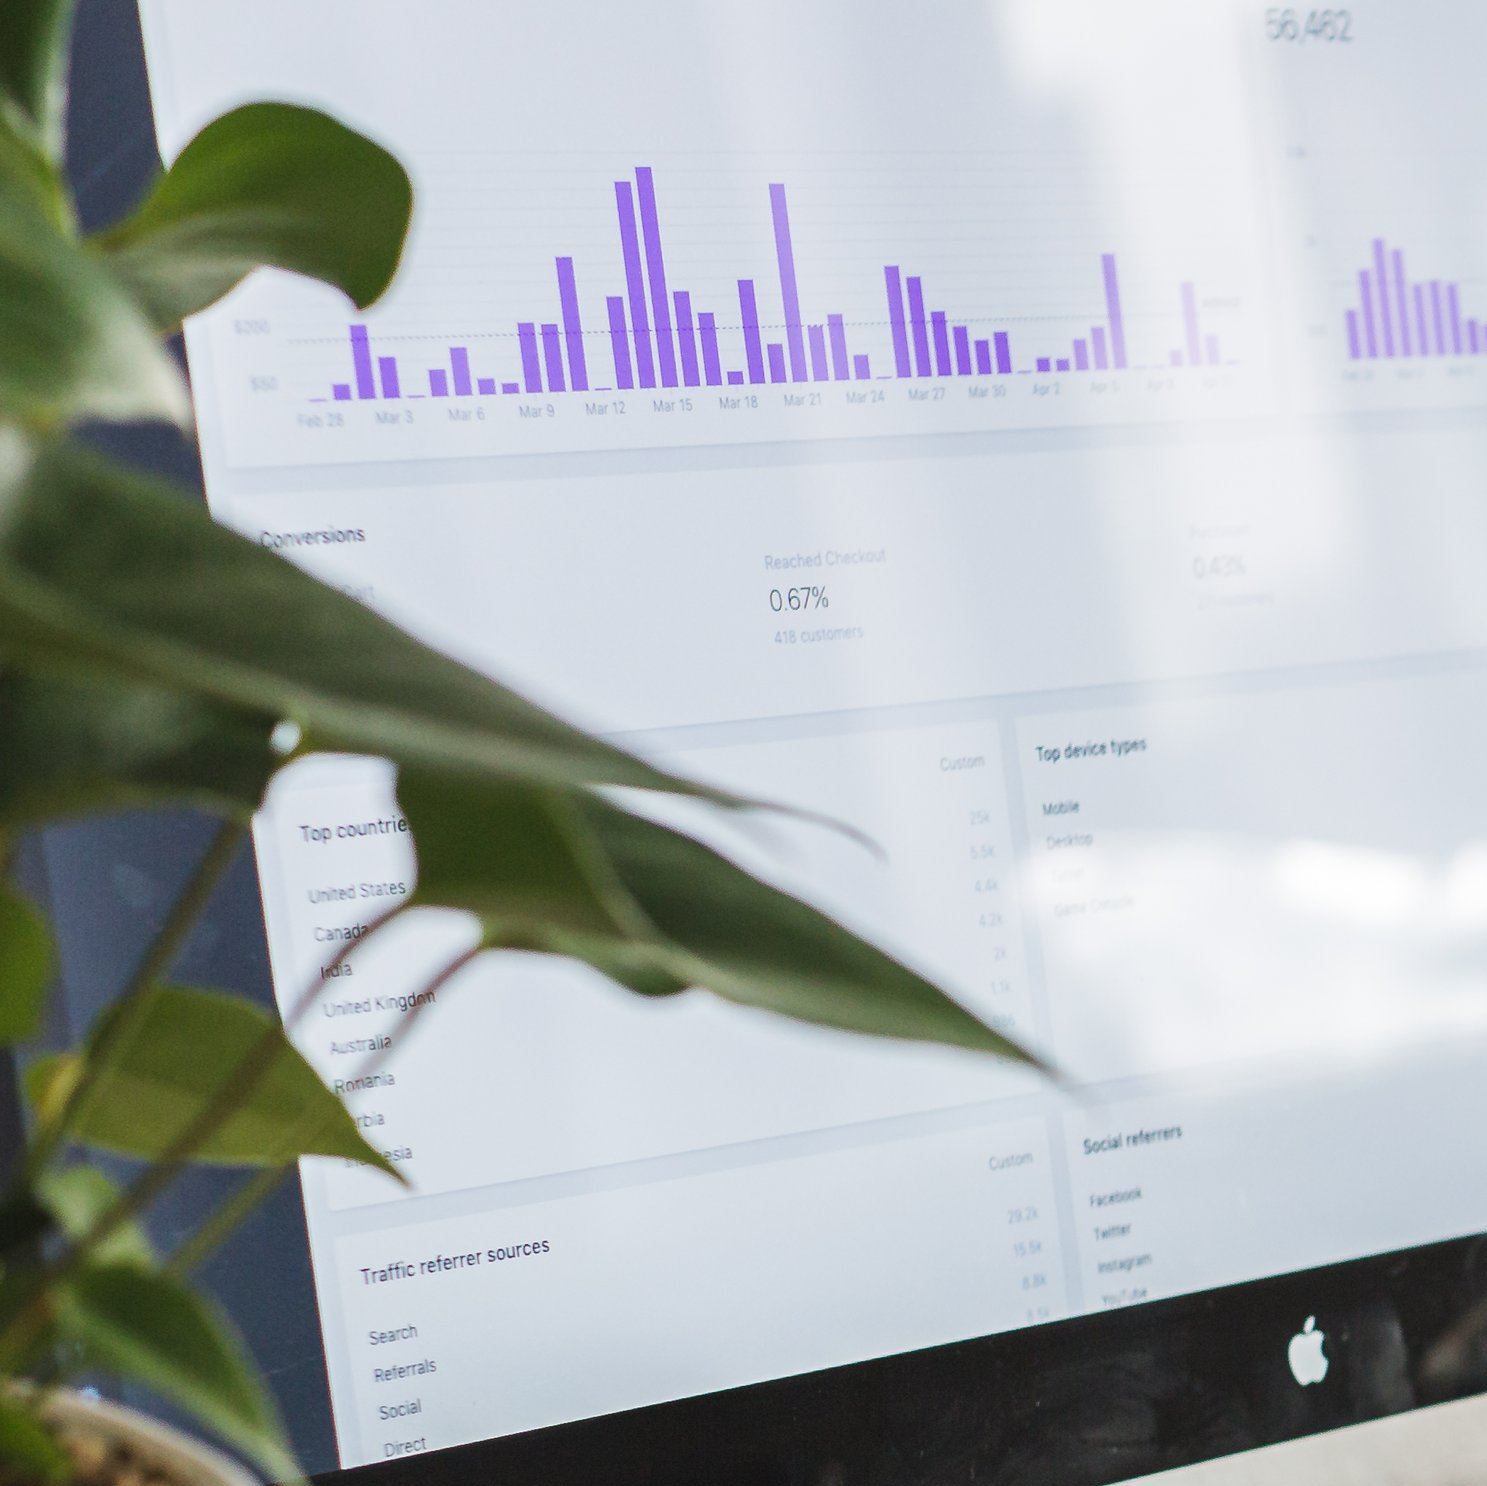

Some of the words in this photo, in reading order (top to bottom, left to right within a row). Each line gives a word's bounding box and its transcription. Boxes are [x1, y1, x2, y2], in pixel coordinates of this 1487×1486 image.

[719, 396, 741, 411] Mar
[742, 395, 759, 410] 18
[783, 393, 805, 408] Mar
[806, 392, 822, 407] 21
[846, 391, 868, 406] Mar
[908, 387, 930, 401] Mar
[449, 409, 475, 423] Mar
[476, 407, 486, 421] 6
[519, 405, 545, 420] Mar
[546, 404, 556, 418] 9
[585, 402, 607, 417] Mar
[608, 400, 627, 416] 12
[653, 400, 676, 414] Mar
[677, 398, 694, 413] 15
[375, 411, 400, 426] Mar
[260, 523, 367, 549] Conversions
[764, 553, 822, 570] Reached
[824, 548, 887, 566] Checkout
[768, 586, 829, 614] 0.67%
[774, 629, 797, 645] 418
[799, 624, 864, 642] customers
[939, 754, 986, 772] Custom
[1034, 744, 1060, 765] Top
[297, 825, 332, 846] Top
[336, 817, 408, 840] countrie
[307, 885, 357, 905] United
[359, 880, 406, 899] States
[313, 923, 369, 943] Canada
[324, 1001, 371, 1019] United
[329, 1033, 392, 1056] Australia
[1083, 1132, 1123, 1155] Social
[1125, 1125, 1183, 1147] referrers
[988, 1152, 1034, 1171] Custom
[360, 1260, 416, 1286] Traffic
[419, 1249, 483, 1276] referrer
[486, 1237, 551, 1264] sources
[367, 1323, 419, 1346] Search
[372, 1357, 438, 1385] Referrals
[377, 1397, 423, 1421] Social
[382, 1436, 428, 1459] Direct
